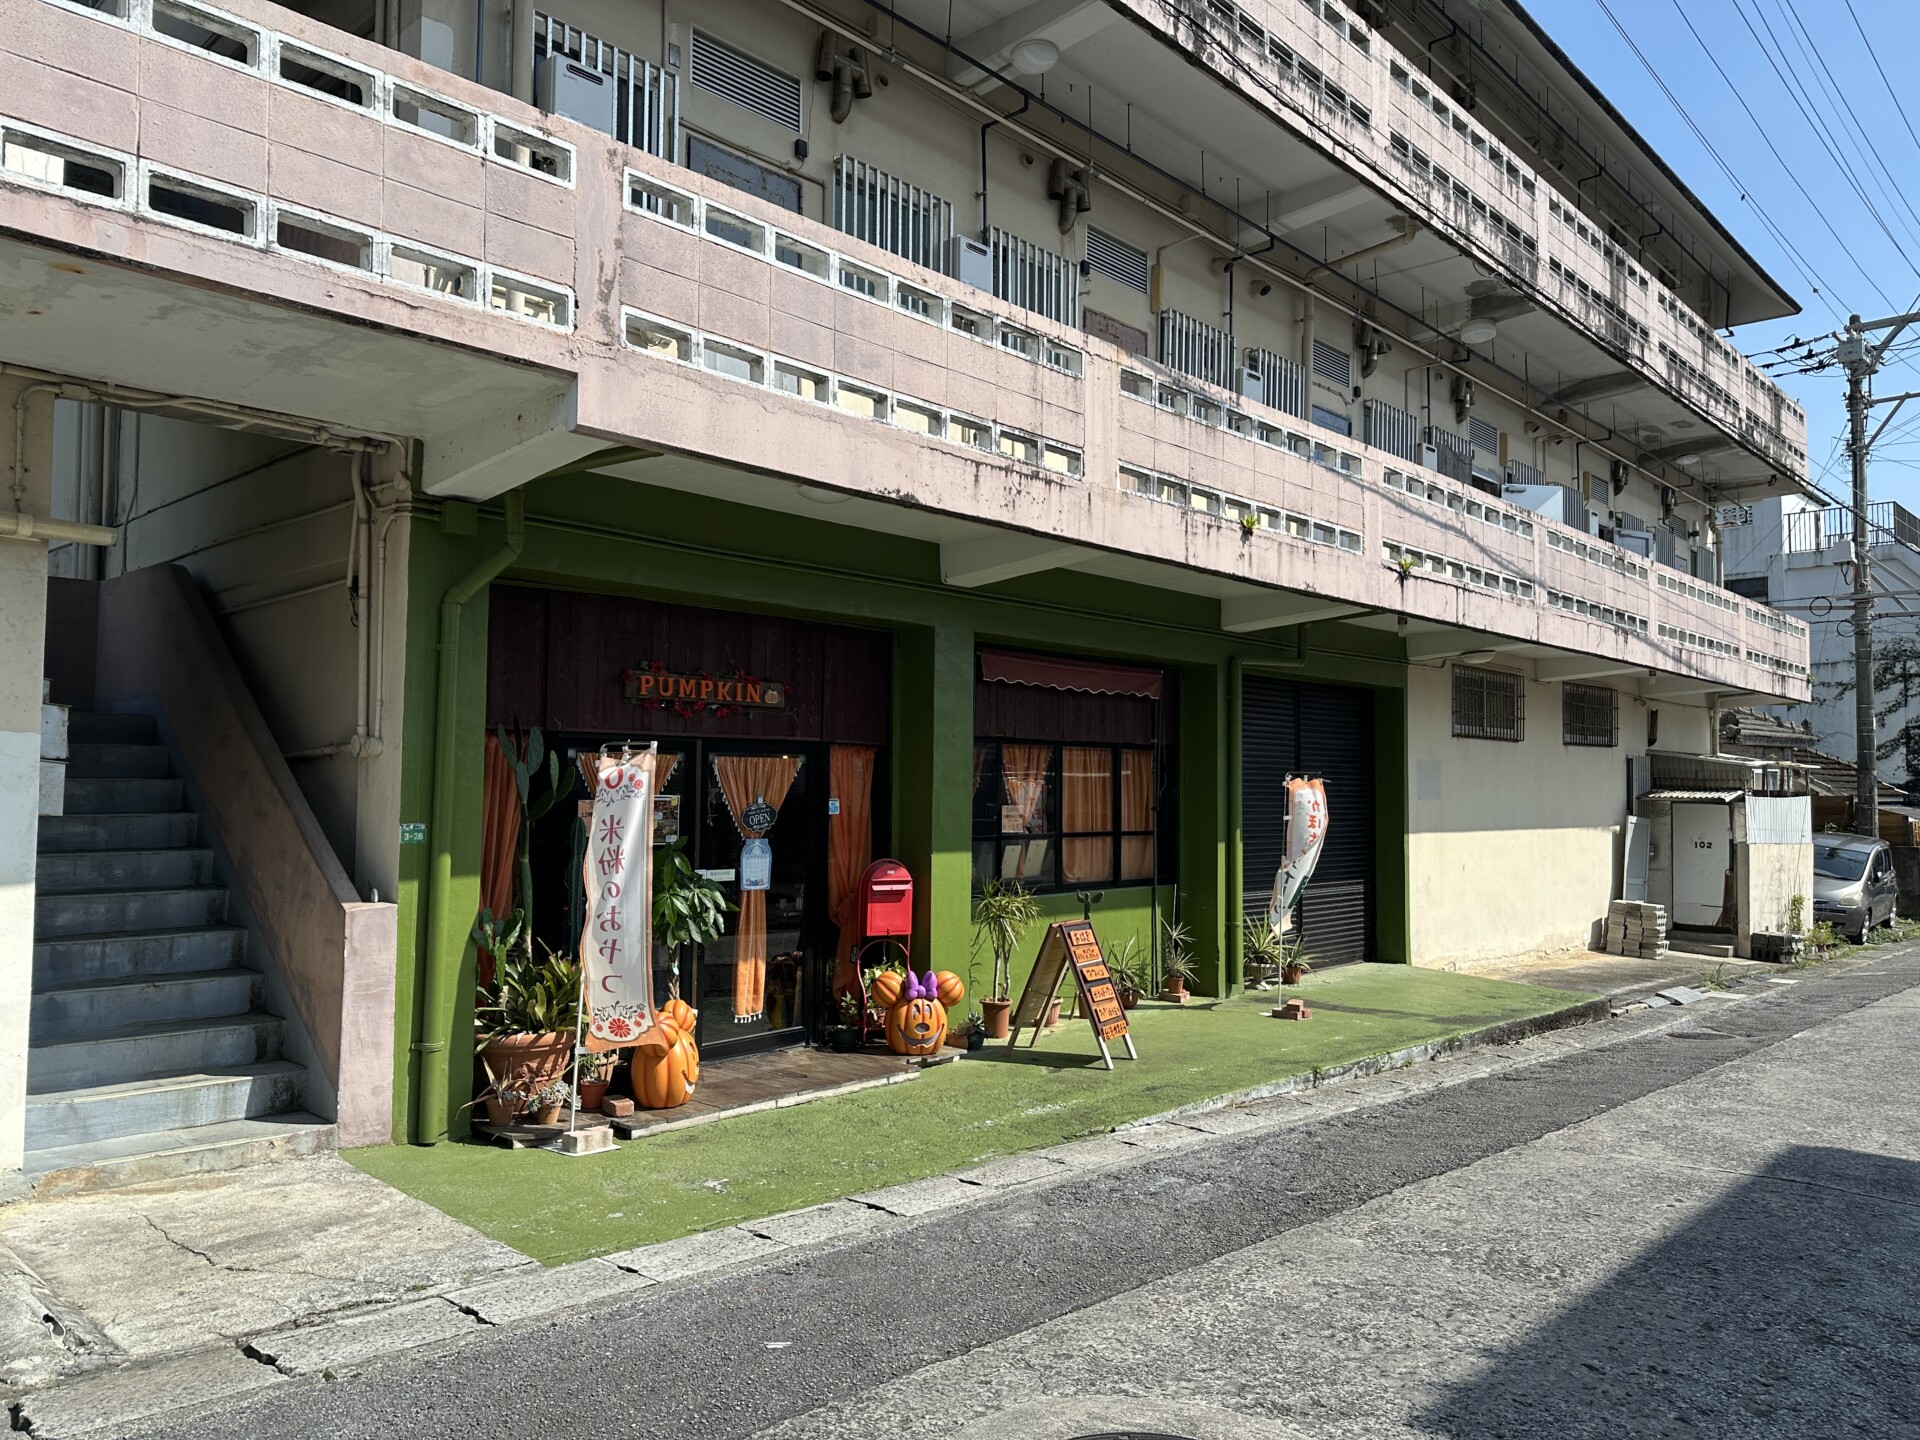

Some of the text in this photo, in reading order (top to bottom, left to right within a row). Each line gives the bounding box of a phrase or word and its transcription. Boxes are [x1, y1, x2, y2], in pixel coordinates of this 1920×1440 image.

[639, 675, 762, 703] PUMPKIN
[749, 812, 771, 826] OPEN
[403, 832, 423, 841] 3-26
[1694, 841, 1713, 849] 102
